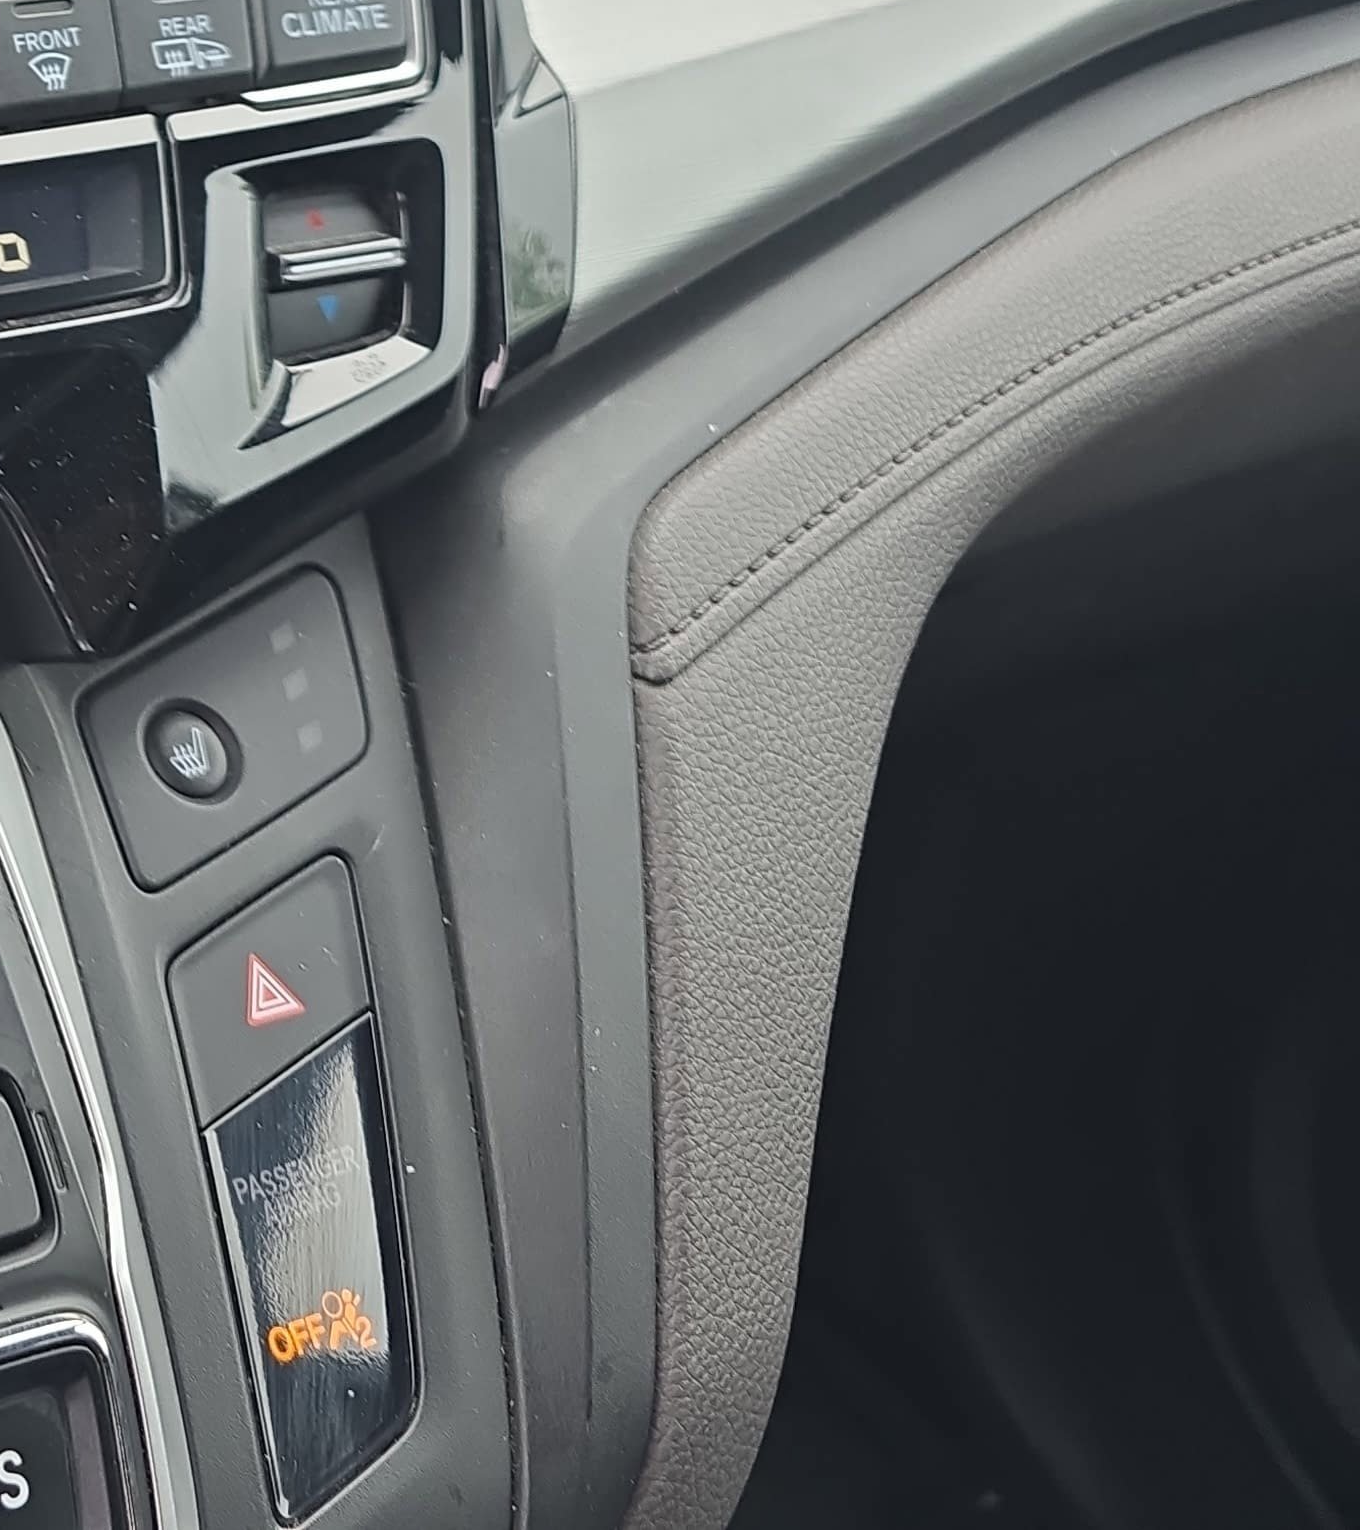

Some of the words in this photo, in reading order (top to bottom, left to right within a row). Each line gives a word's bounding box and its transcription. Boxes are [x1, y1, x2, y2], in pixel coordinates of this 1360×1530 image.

[159, 15, 212, 36] REAR
[282, 1, 390, 37] CLIMATE
[13, 27, 79, 54] FRONT
[232, 1144, 361, 1205] PASSENGER
[267, 1312, 326, 1363] OFF
